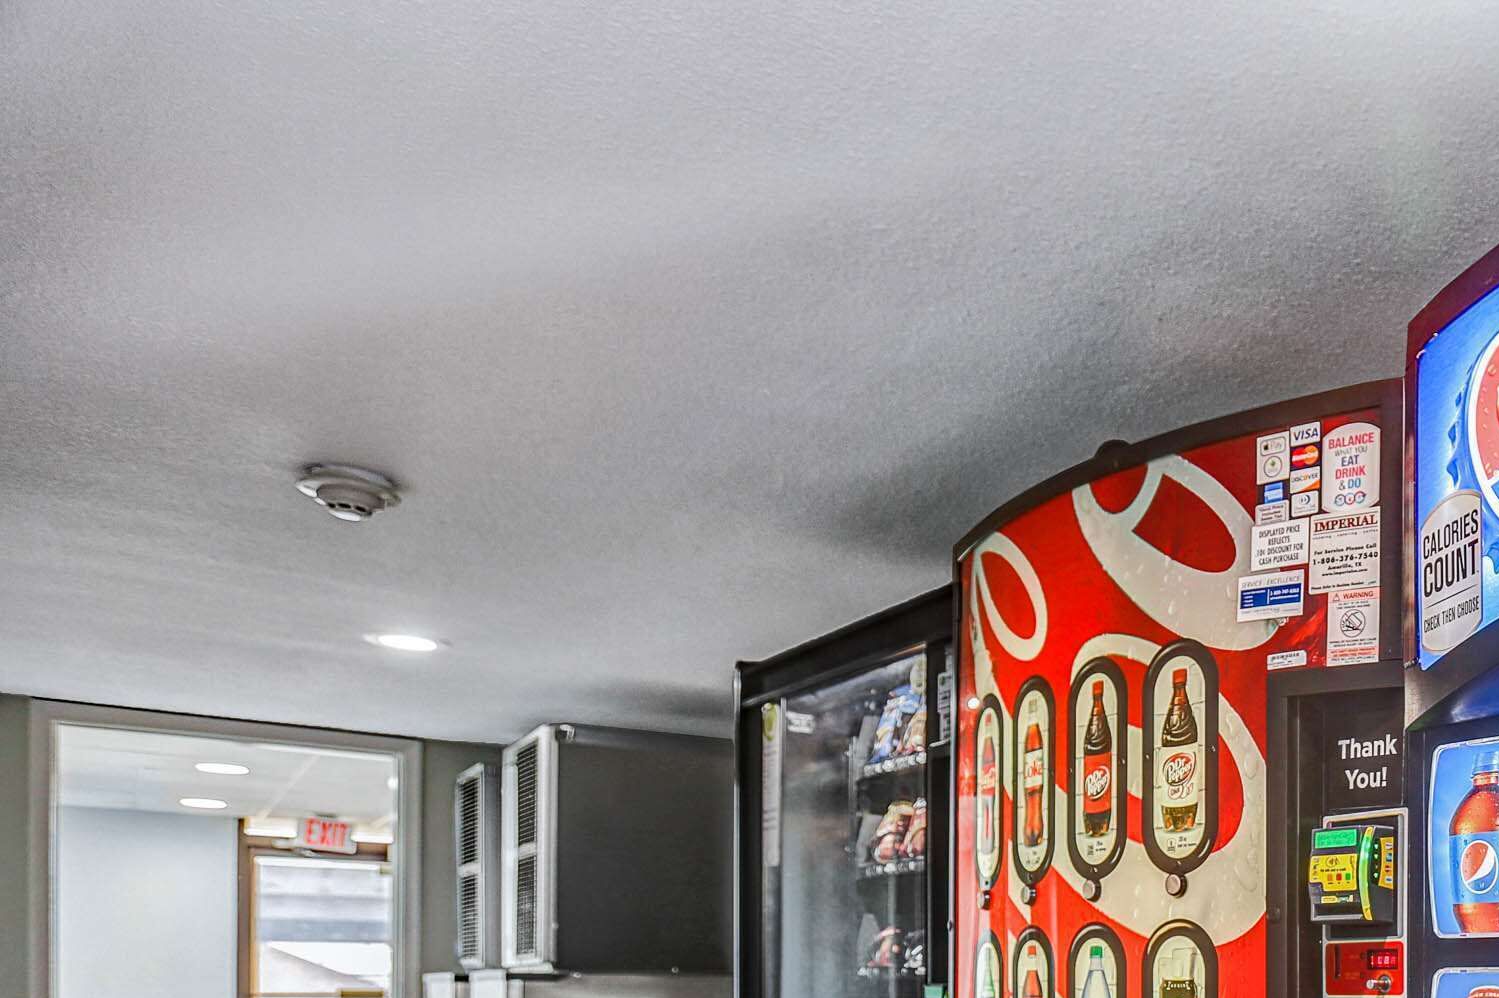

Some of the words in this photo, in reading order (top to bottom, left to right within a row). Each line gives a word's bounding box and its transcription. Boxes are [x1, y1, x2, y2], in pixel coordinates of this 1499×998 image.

[1293, 427, 1318, 441] VISA
[1328, 432, 1374, 450] BALANCE
[1341, 455, 1360, 466] EAT
[1335, 466, 1366, 480] DRINK
[1339, 480, 1346, 490] &
[1347, 478, 1361, 489] DO
[1314, 514, 1378, 533] IMPERIAL
[1259, 526, 1284, 539] DISPLAYED
[1286, 524, 1301, 534] PRICE
[1423, 509, 1479, 560] CALORIES
[1268, 535, 1290, 546] REFLECTS
[1267, 545, 1292, 556] DISCOUNT
[1293, 543, 1304, 551] FOR
[1258, 557, 1271, 566] CASH
[1273, 552, 1299, 563] PURCHASE
[1343, 591, 1374, 600] WARNING
[1424, 613, 1441, 633] CHECK
[1442, 605, 1456, 625] THEN
[1457, 596, 1479, 618] CHOOSE
[1337, 733, 1398, 760] Thank
[1345, 766, 1388, 791] You!
[305, 817, 350, 849] EXIT
